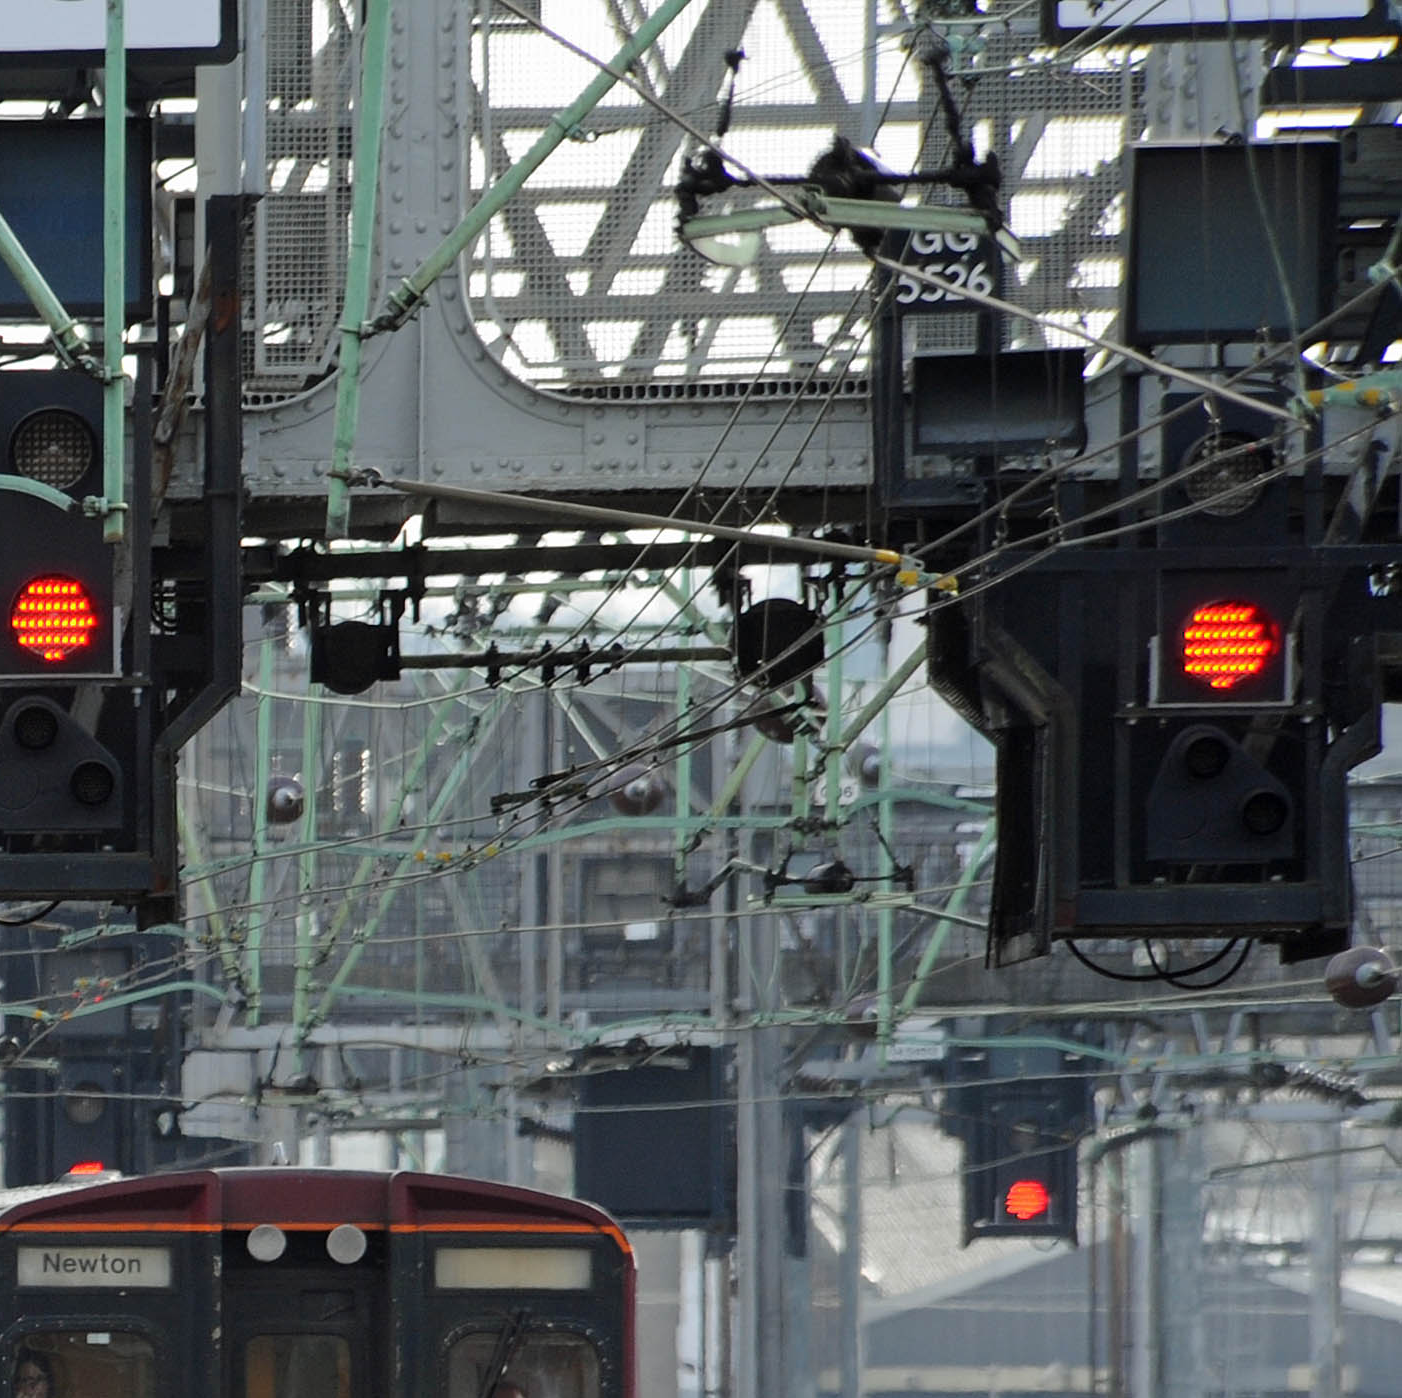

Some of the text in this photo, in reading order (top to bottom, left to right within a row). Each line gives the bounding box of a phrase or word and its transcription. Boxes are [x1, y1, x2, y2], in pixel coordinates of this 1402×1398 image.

[911, 231, 979, 255] GG
[896, 261, 993, 304] 5526
[42, 1252, 141, 1274] Newton
